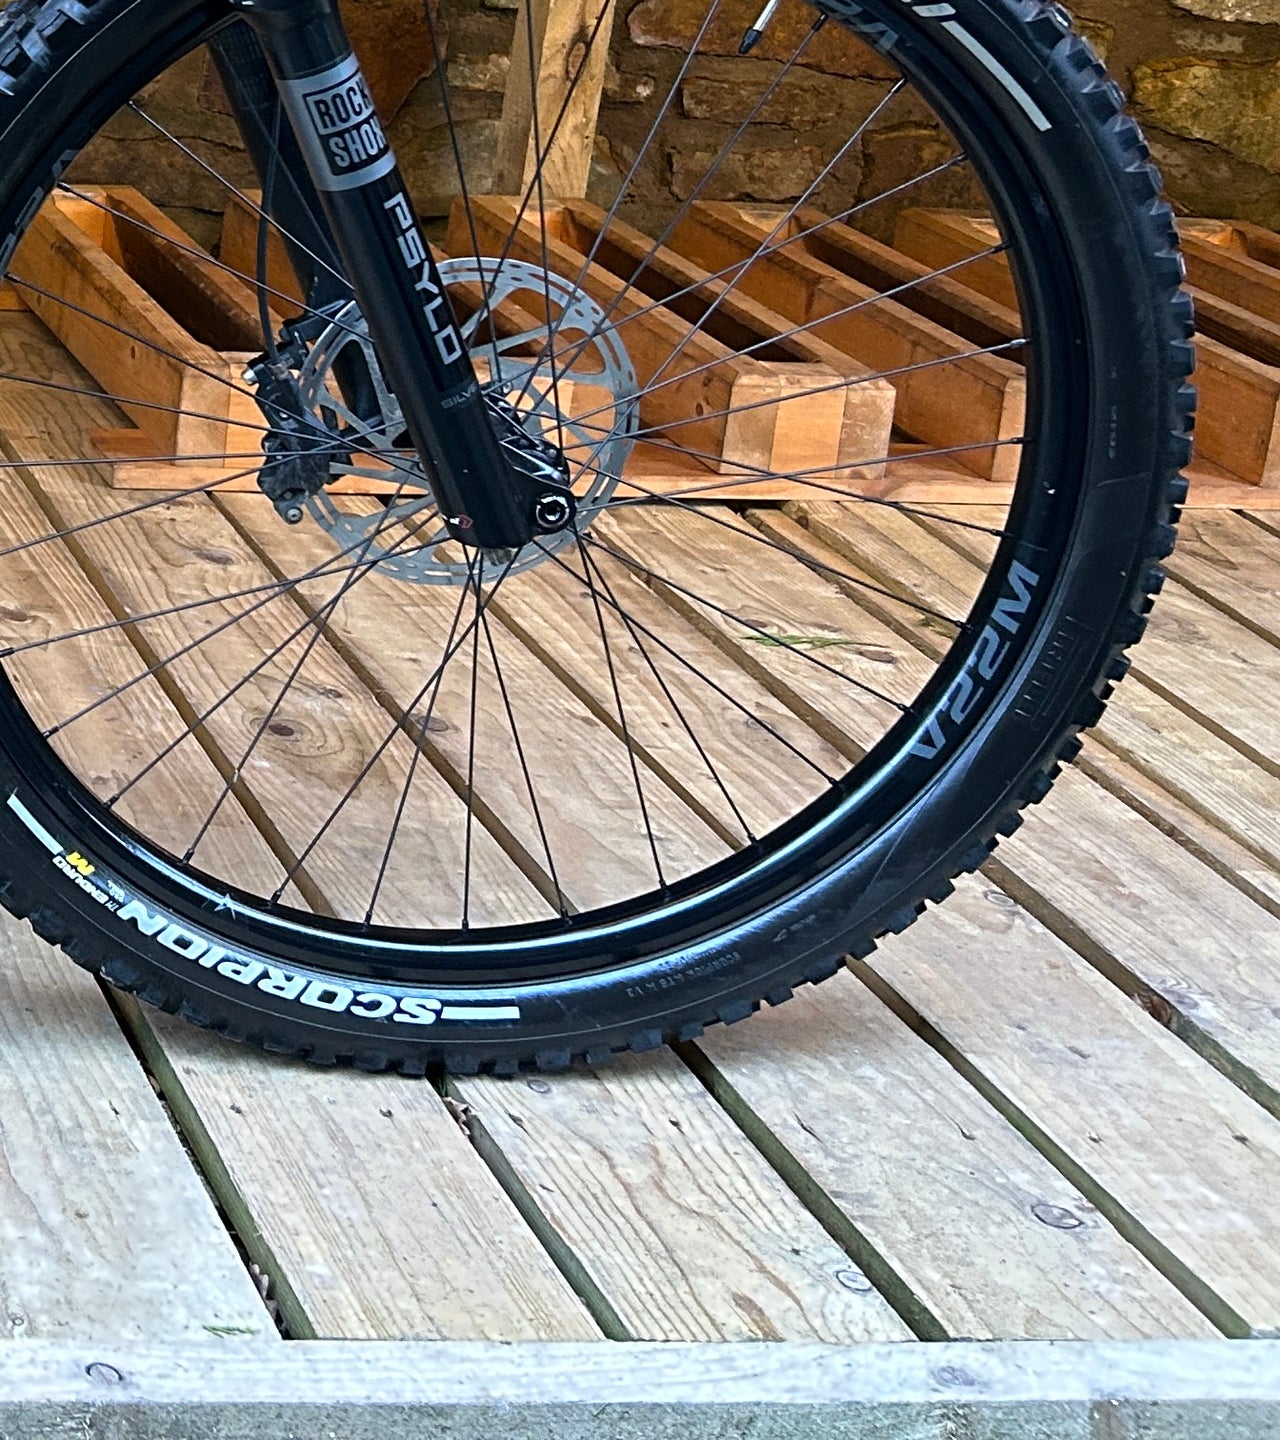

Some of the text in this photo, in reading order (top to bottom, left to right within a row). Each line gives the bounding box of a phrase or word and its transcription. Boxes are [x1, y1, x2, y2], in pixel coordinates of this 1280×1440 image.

[312, 77, 374, 130] ROCK
[383, 190, 463, 365] PSYLO
[908, 559, 1041, 760] V22M
[115, 898, 442, 1026] SCORPION
